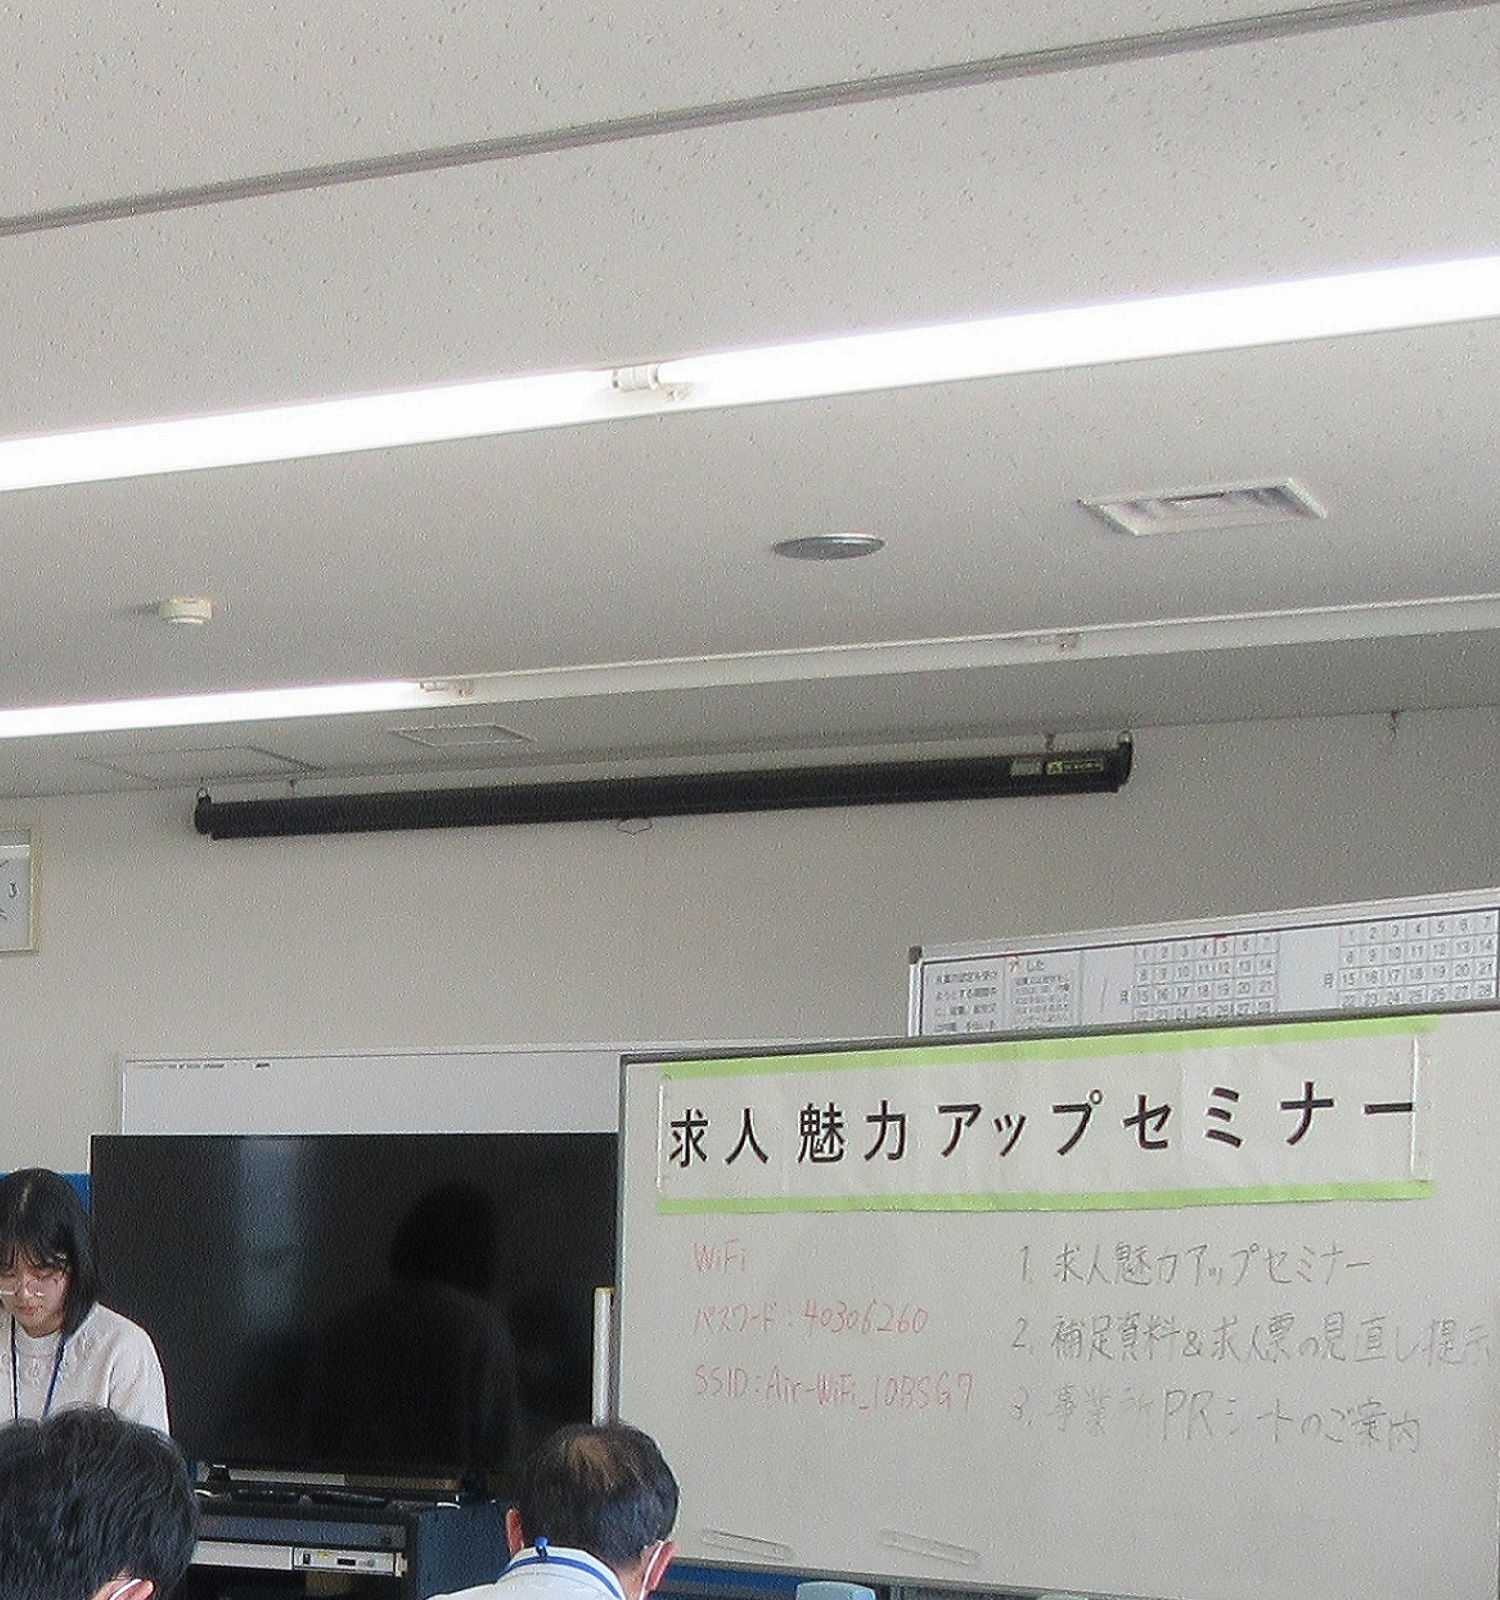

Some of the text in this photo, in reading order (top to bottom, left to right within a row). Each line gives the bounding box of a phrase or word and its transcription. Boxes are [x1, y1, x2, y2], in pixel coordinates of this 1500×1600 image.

[667, 1078, 1415, 1170] 求人魅力アップセミナー
